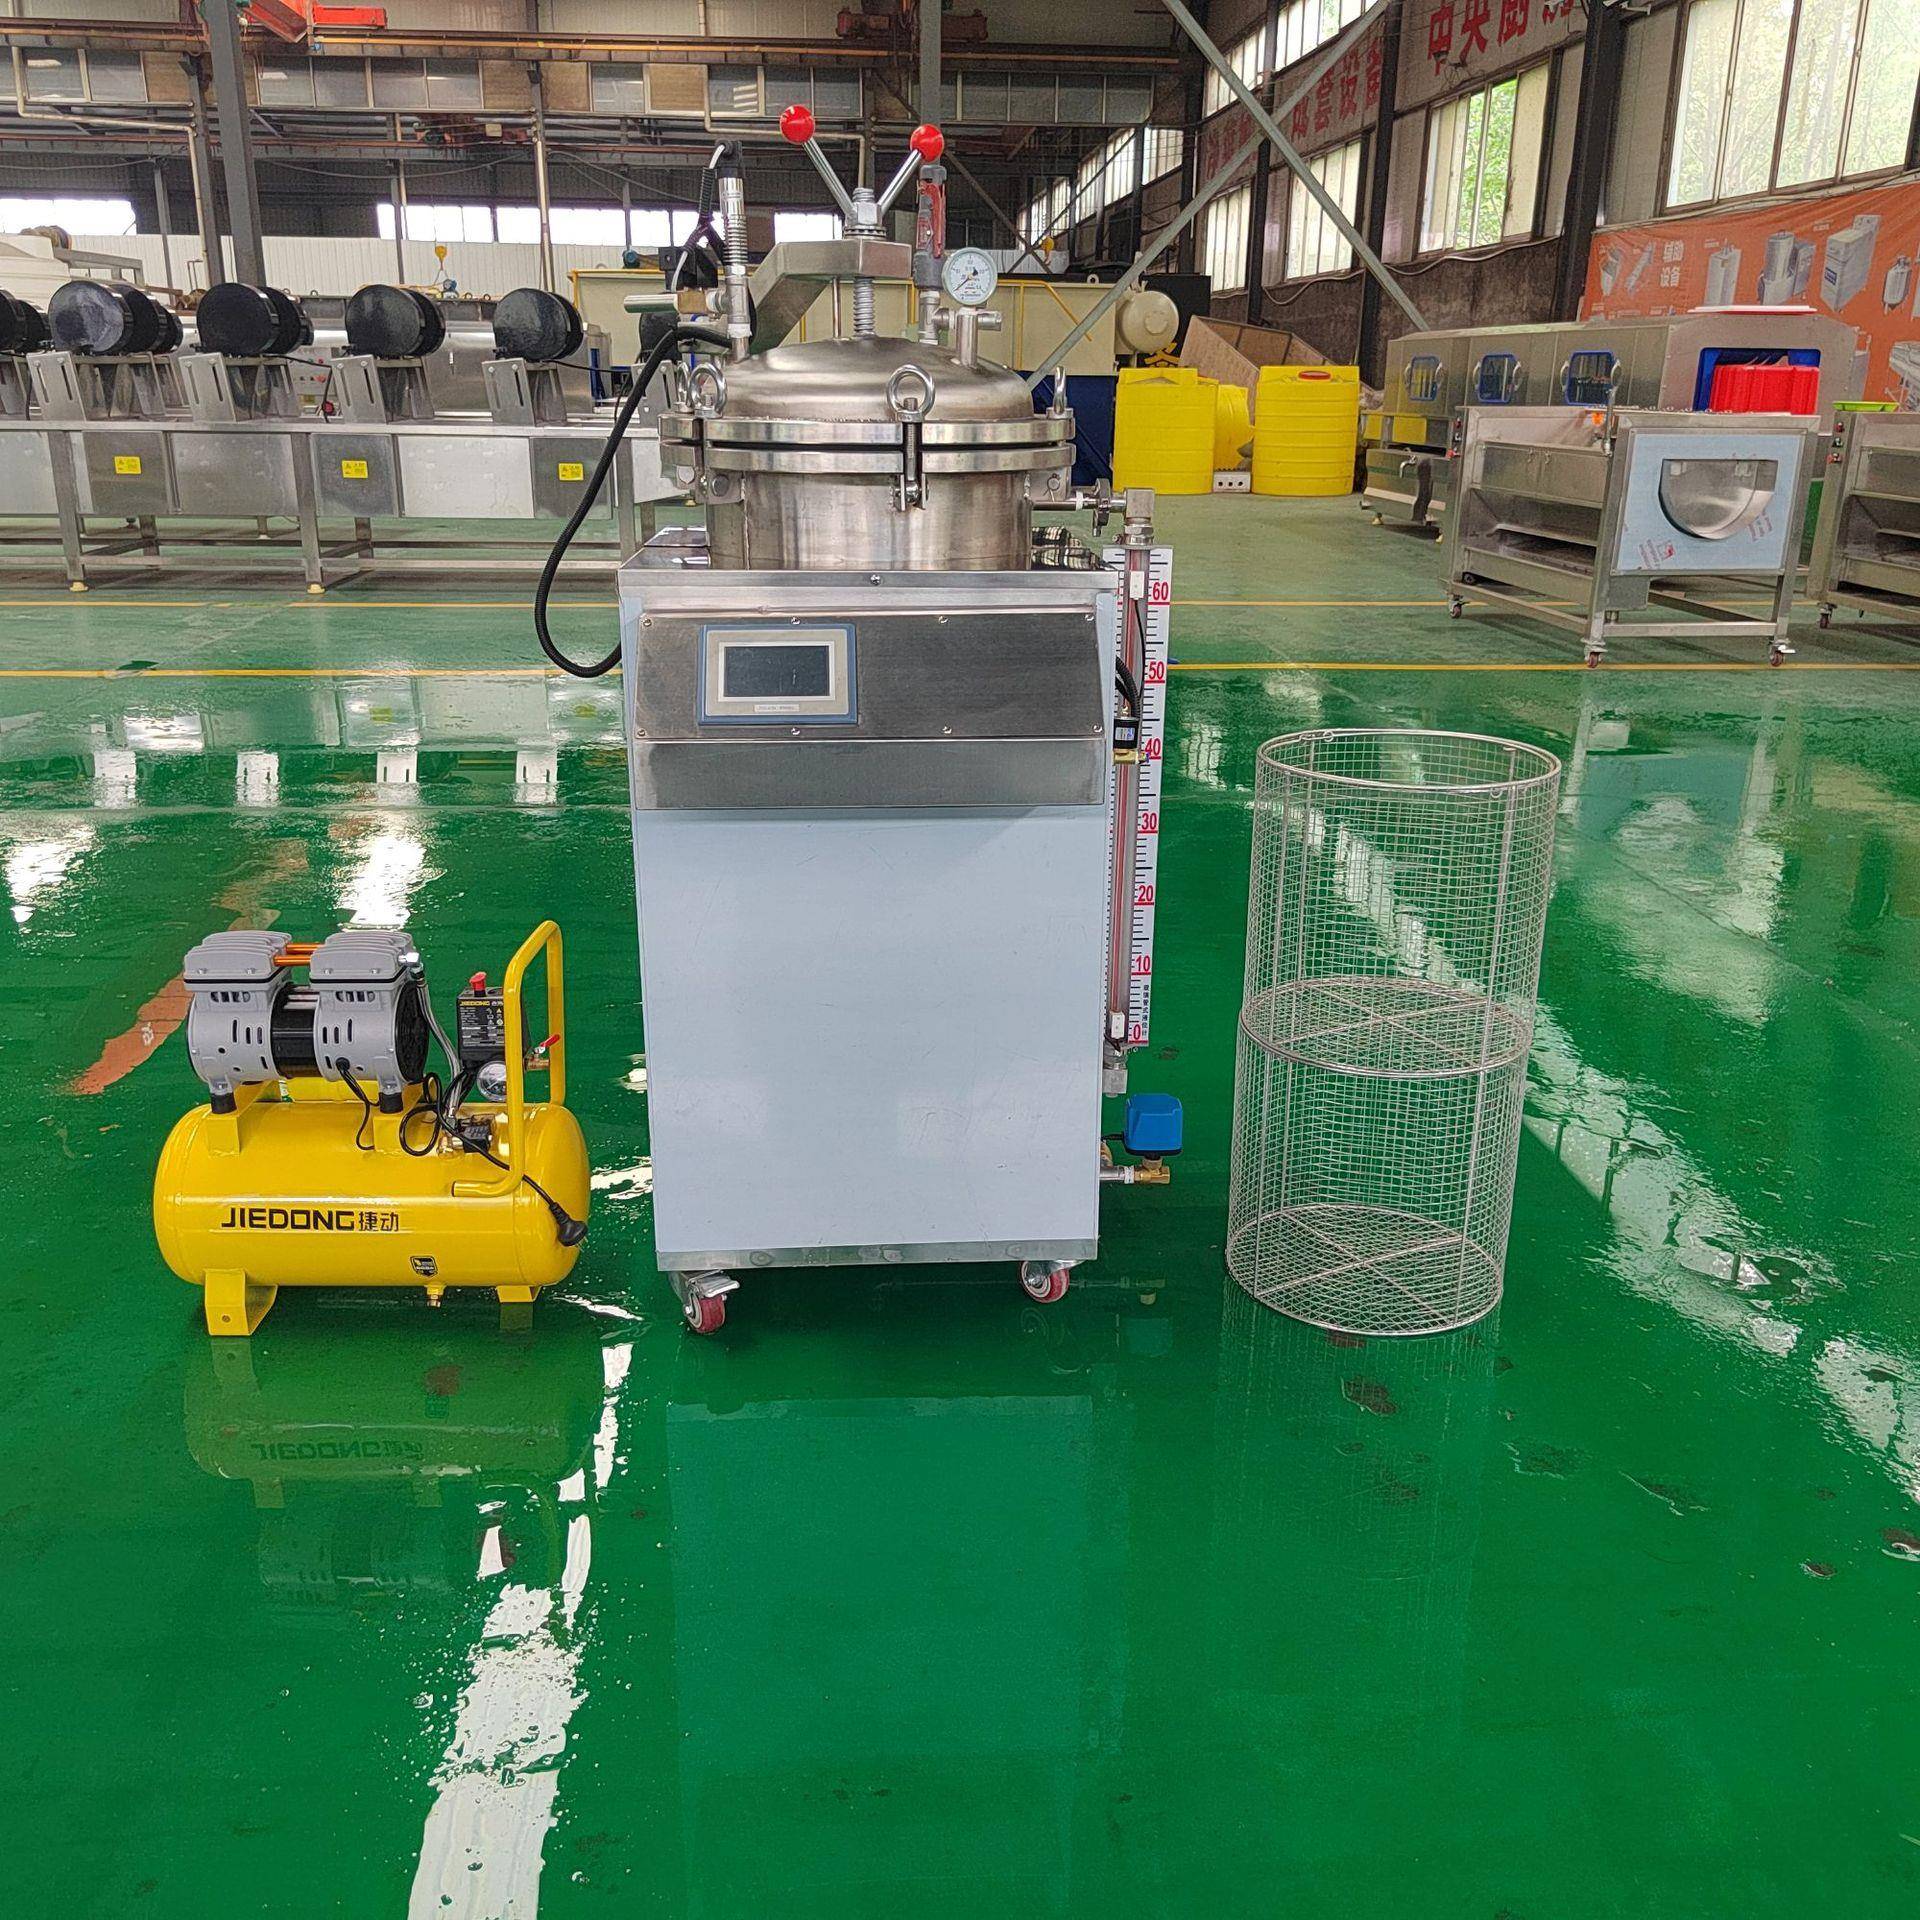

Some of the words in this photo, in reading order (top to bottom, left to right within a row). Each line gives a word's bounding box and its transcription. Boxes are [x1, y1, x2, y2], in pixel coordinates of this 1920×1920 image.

[1660, 266, 1681, 288] 设备
[1152, 581, 1169, 601] 60
[1148, 661, 1165, 680] 50
[1145, 738, 1161, 756] 40
[1141, 812, 1158, 830] 30
[1138, 885, 1154, 902] 20
[1135, 955, 1151, 972] 10
[1133, 1023, 1142, 1041] 0
[221, 1207, 355, 1231] JIEDONG
[358, 1211, 399, 1232] 捷动
